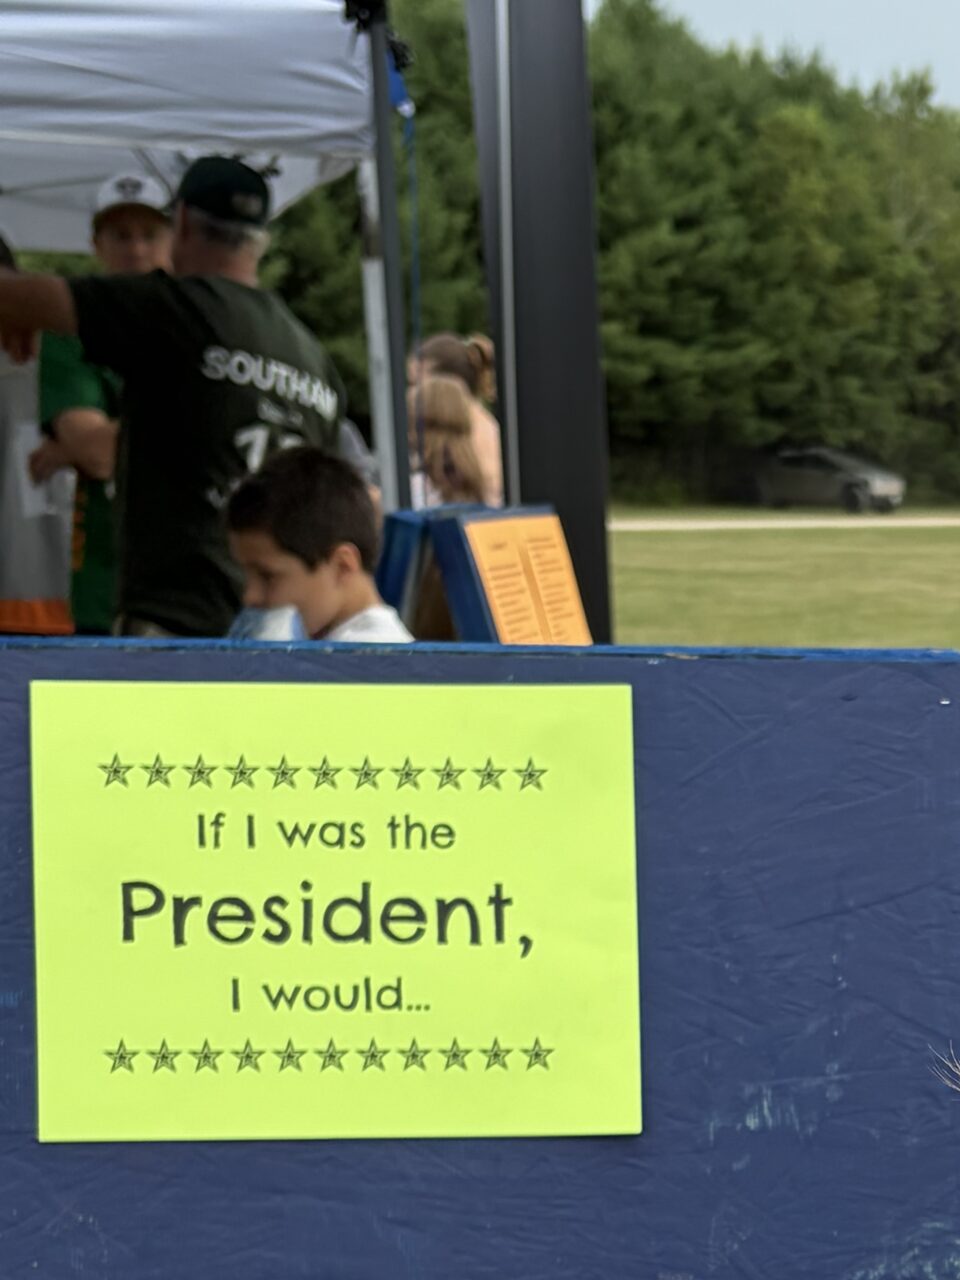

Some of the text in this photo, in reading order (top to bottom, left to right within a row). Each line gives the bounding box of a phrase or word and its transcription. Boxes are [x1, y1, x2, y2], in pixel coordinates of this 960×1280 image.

[196, 811, 457, 850] If I was the
[119, 879, 535, 960] President,
[230, 975, 432, 1013] I would...
